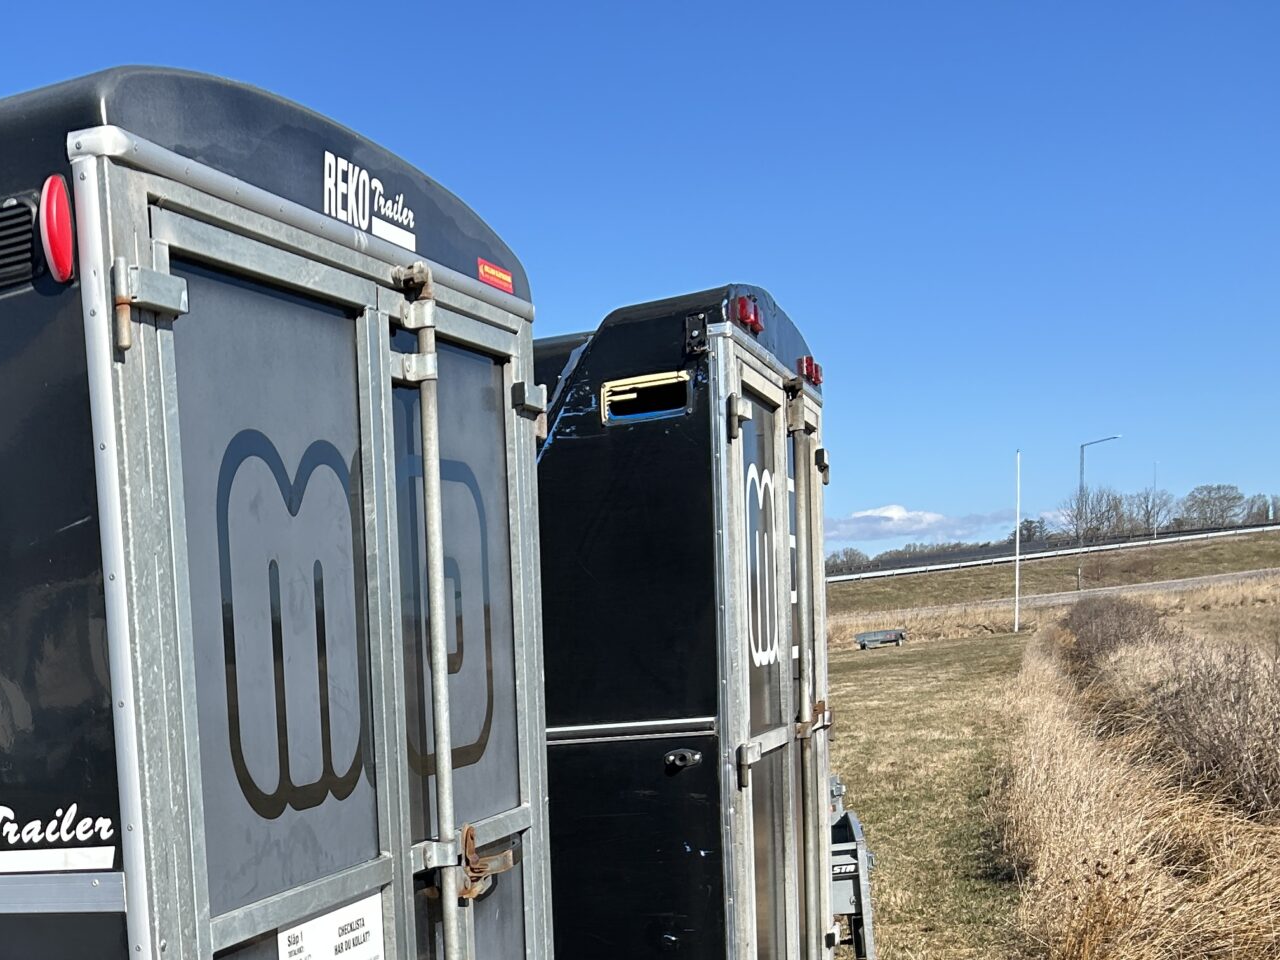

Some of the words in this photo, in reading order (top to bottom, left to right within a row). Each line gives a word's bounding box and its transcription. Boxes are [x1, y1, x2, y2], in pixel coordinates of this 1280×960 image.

[324, 150, 370, 231] REKO
[370, 177, 415, 229] Trailer
[216, 429, 494, 820] mo
[337, 917, 366, 938] CHECKLISTA
[287, 933, 300, 948] Släp
[333, 942, 344, 956] HAR
[344, 938, 352, 951] DU
